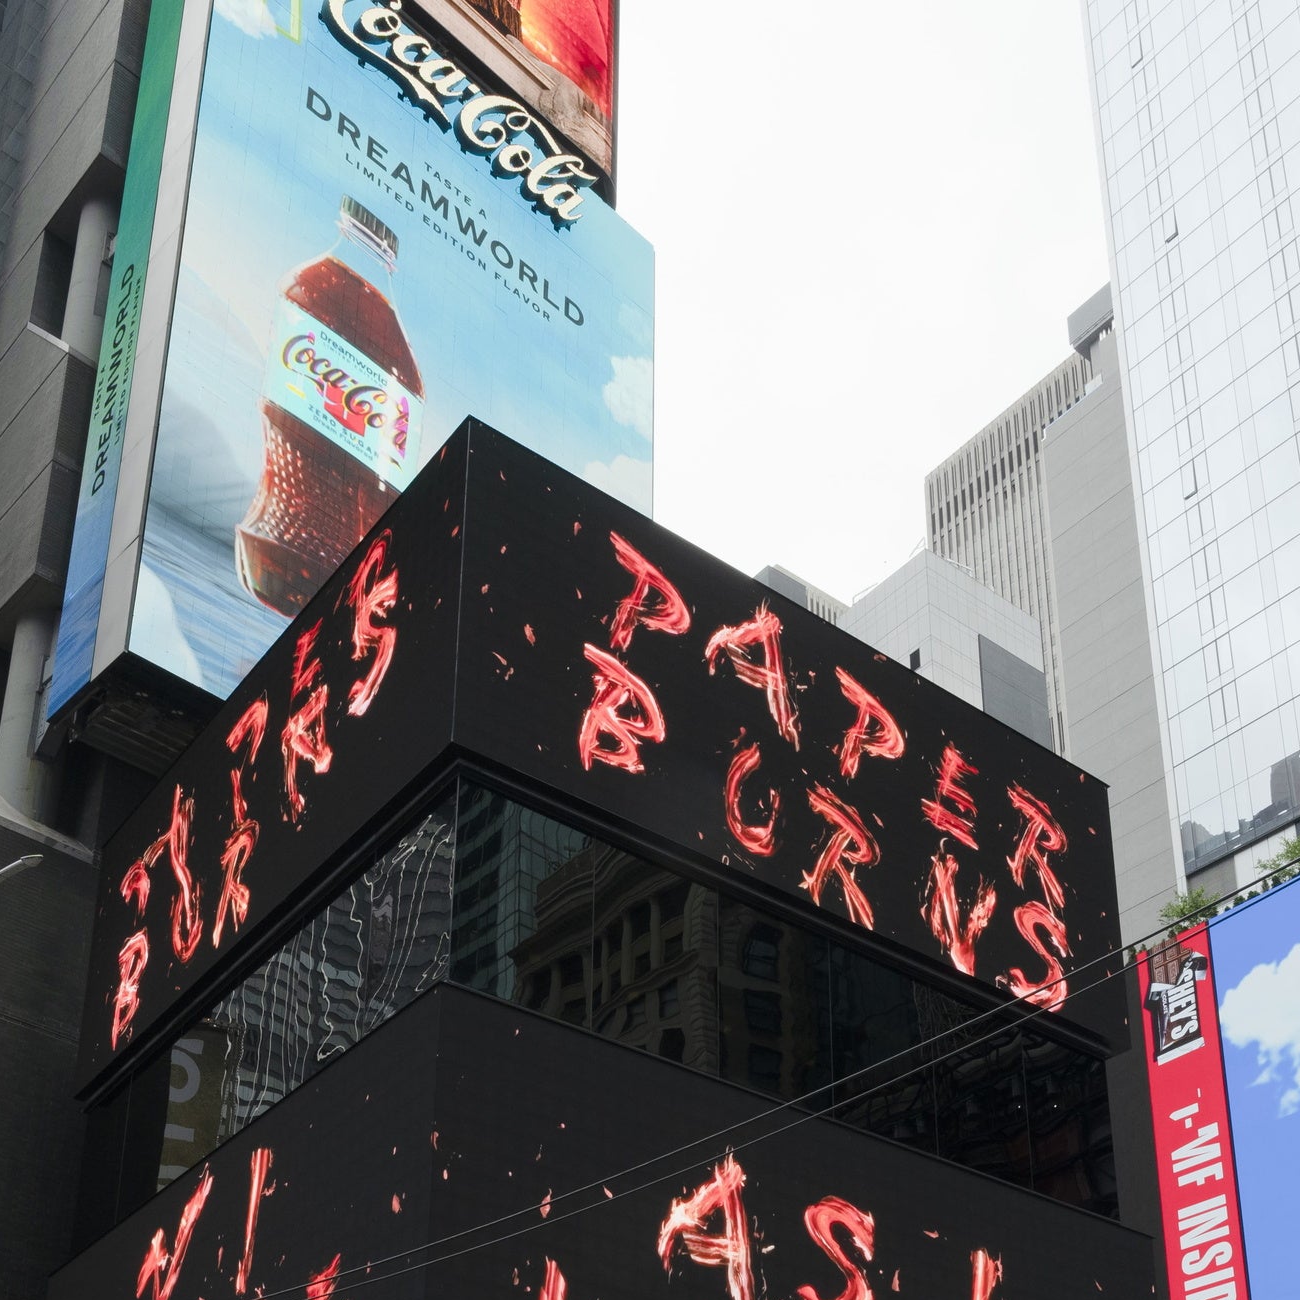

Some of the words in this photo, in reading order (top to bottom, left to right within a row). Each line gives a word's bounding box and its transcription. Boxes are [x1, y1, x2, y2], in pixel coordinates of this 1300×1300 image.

[306, 86, 585, 327] DREAMWORLD
[329, 0, 599, 221] Coca-Cola
[424, 161, 472, 206] TASTE
[478, 208, 487, 220] A
[345, 152, 415, 212] LIMITED
[423, 213, 487, 271] EDITION
[494, 272, 551, 322] FLAVOR
[91, 263, 135, 497] DREAMWORLD
[282, 335, 409, 460] Coca-Cola
